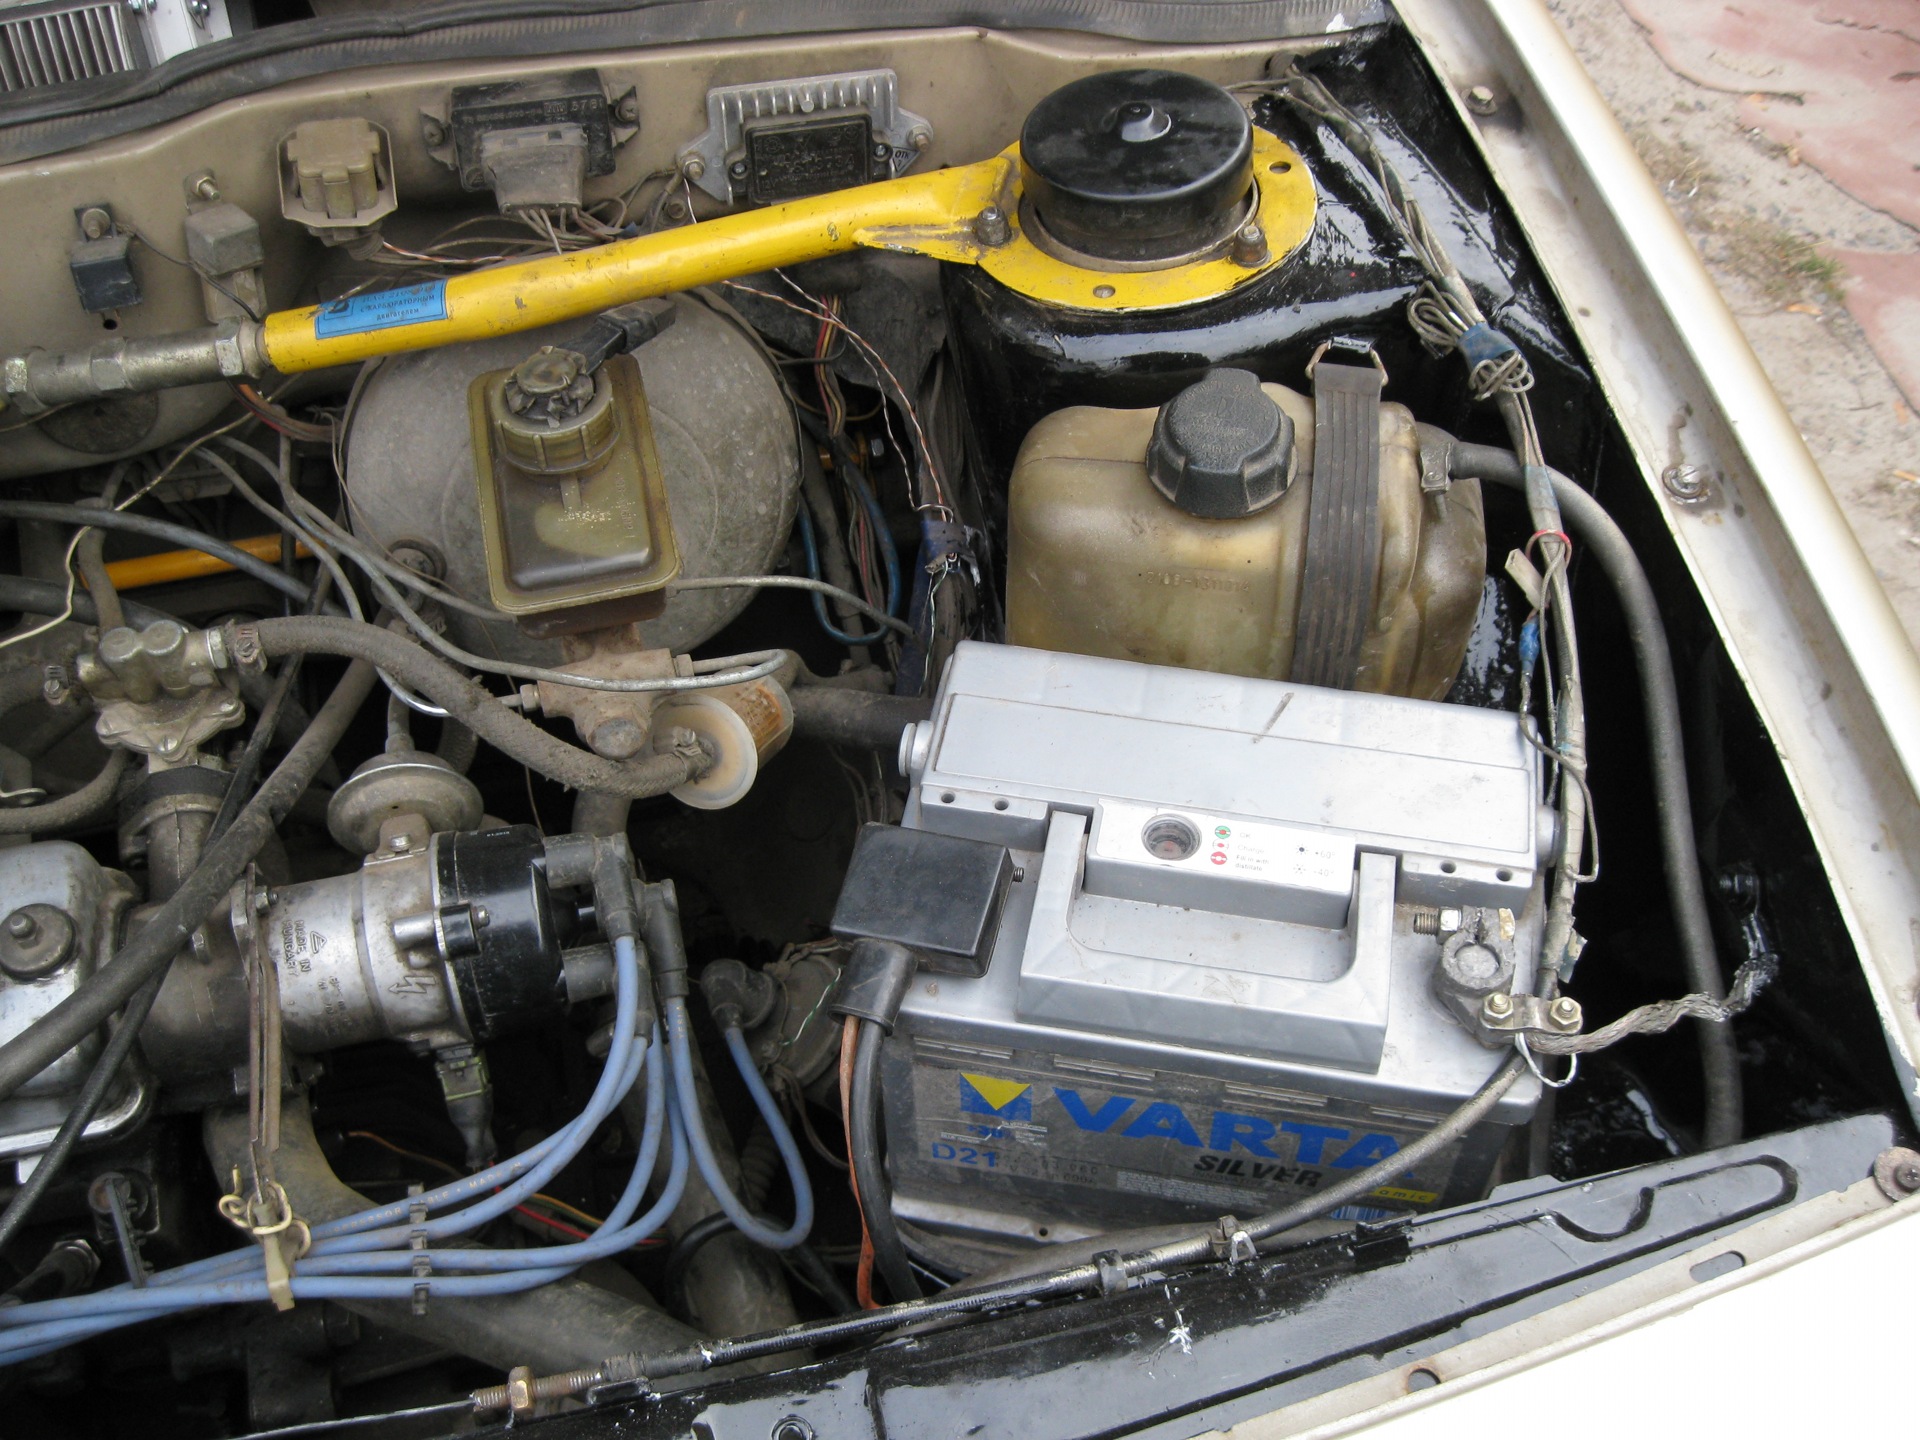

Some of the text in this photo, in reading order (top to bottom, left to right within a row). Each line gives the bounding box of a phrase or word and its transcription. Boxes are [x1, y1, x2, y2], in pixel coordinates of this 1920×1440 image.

[282, 918, 299, 977] HUNGARY
[294, 919, 312, 973] MADE IN
[931, 1141, 997, 1168] D21
[1052, 1086, 1414, 1179] VARTA
[1193, 1154, 1323, 1188] SILVER
